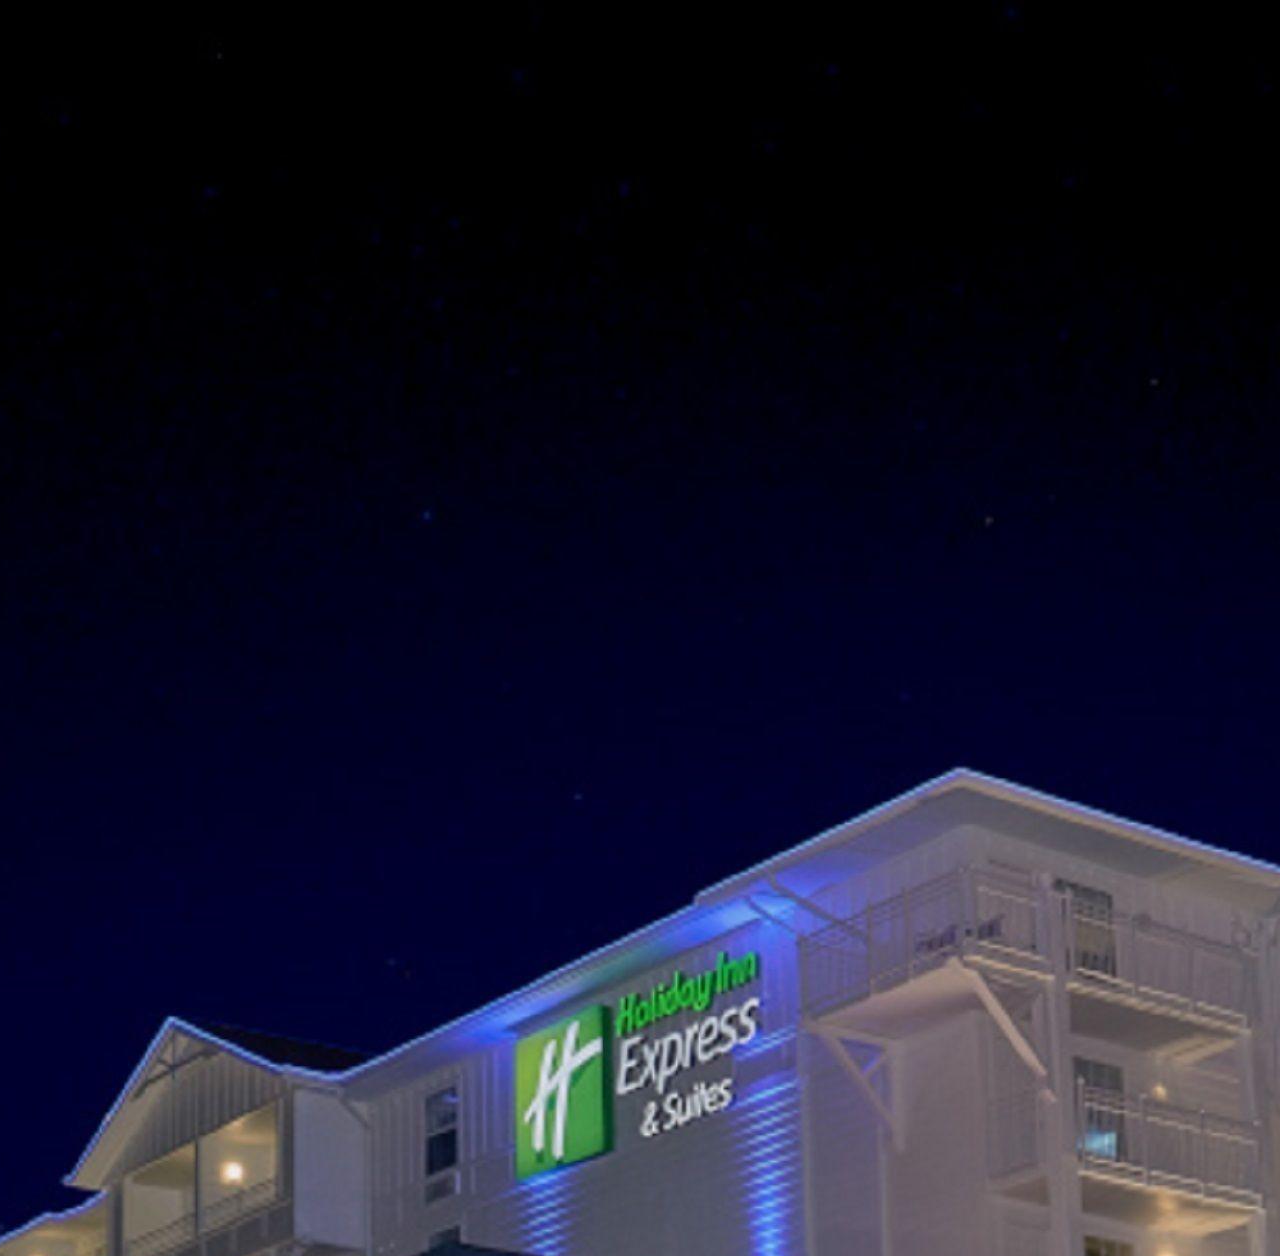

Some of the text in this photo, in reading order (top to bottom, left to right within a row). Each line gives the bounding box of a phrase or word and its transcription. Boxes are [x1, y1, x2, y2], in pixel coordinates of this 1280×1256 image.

[615, 950, 758, 1037] Holiday Inn
[616, 997, 760, 1095] Express
[640, 1077, 732, 1137] & Suites
